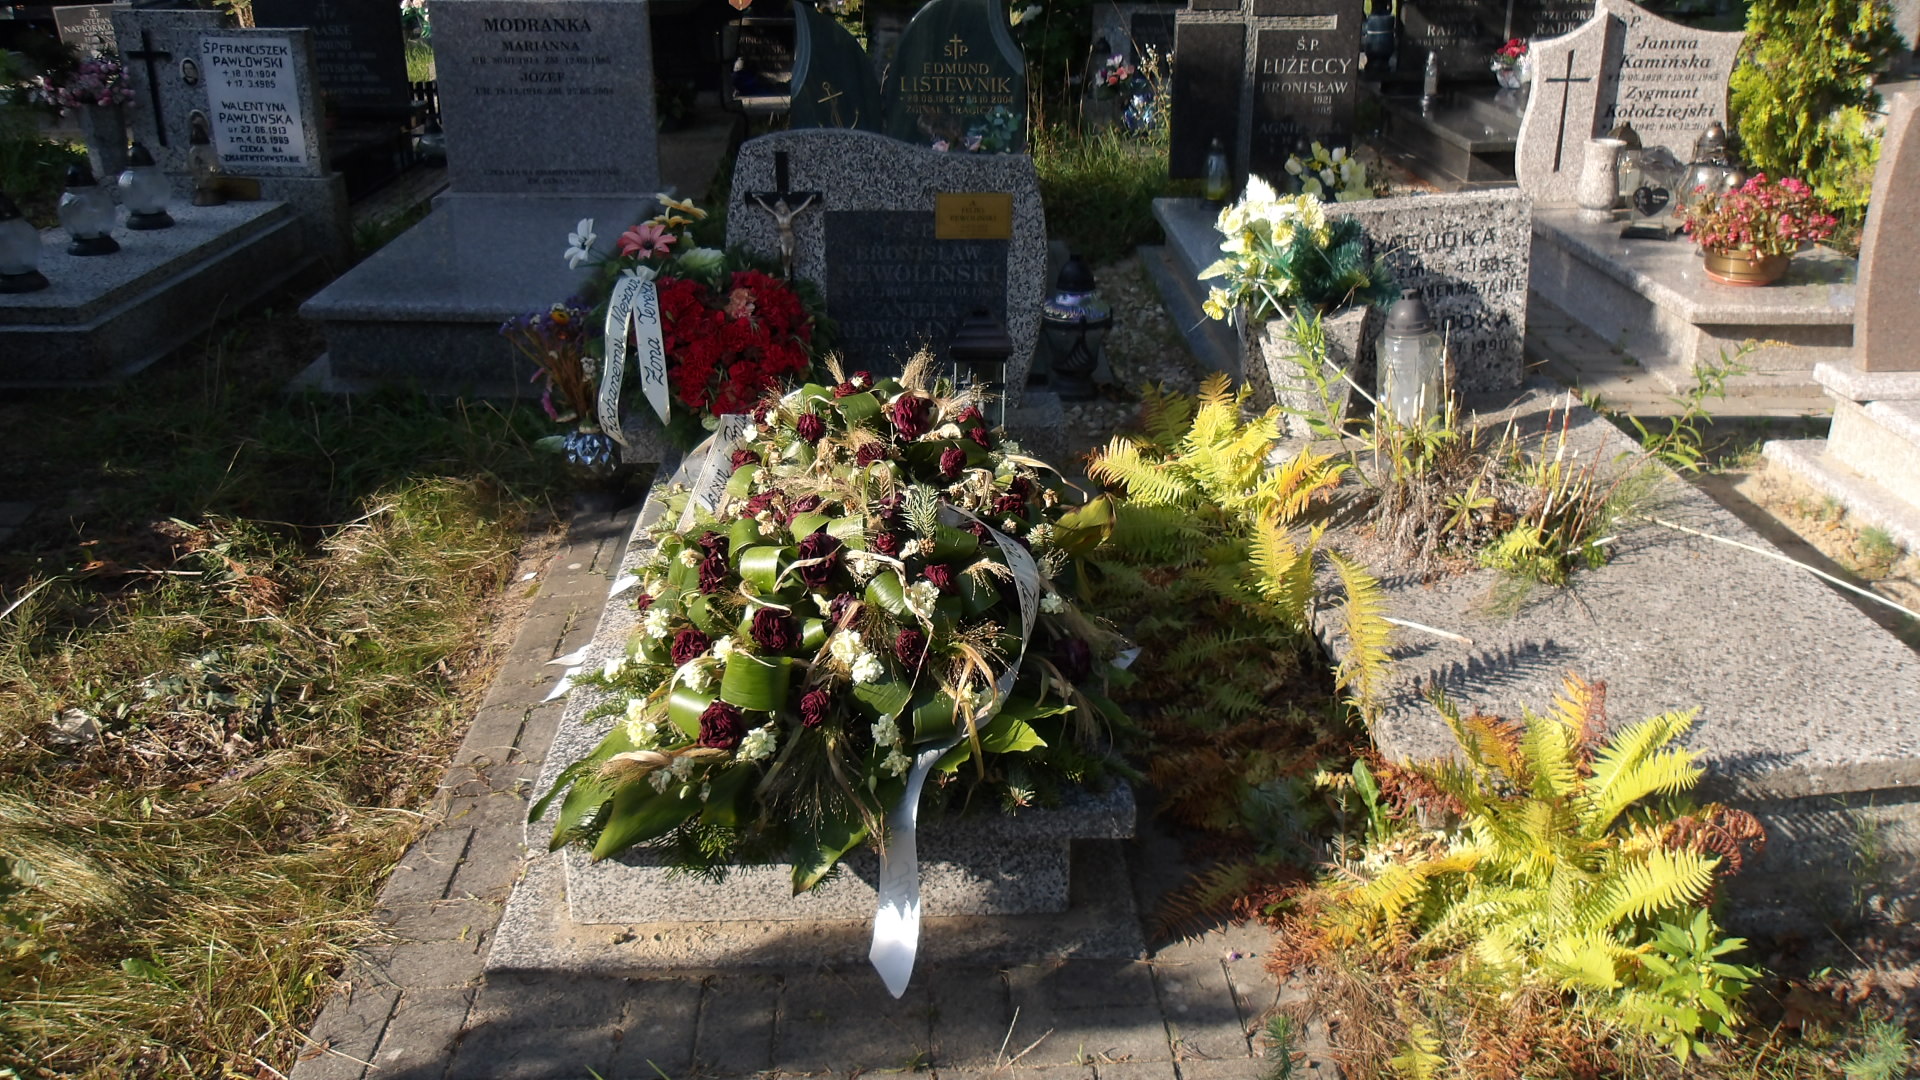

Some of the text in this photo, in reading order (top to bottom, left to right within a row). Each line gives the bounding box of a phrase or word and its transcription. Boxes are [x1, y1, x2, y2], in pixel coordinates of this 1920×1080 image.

[484, 18, 592, 33] MODRANKA
[1536, 22, 1586, 34] RADK
[502, 40, 581, 52] MARIANNA
[1637, 35, 1698, 50] Janina
[213, 56, 283, 69] PAWŁOWSKI
[1263, 55, 1353, 75] ŁUŻECCY
[1621, 53, 1712, 69] Kamińska
[923, 63, 990, 76] EDMUND
[900, 76, 1012, 93] LISTEWNIK
[1262, 81, 1349, 94] BRONISŁAW
[1625, 85, 1699, 103] Zygmunt
[221, 101, 287, 113] WALENTYNA
[1604, 102, 1716, 121] Kołodziejski
[219, 112, 294, 125] PAWŁOWSKA
[240, 145, 283, 153] CZEKA NA
[601, 339, 624, 440] Kochanemu
